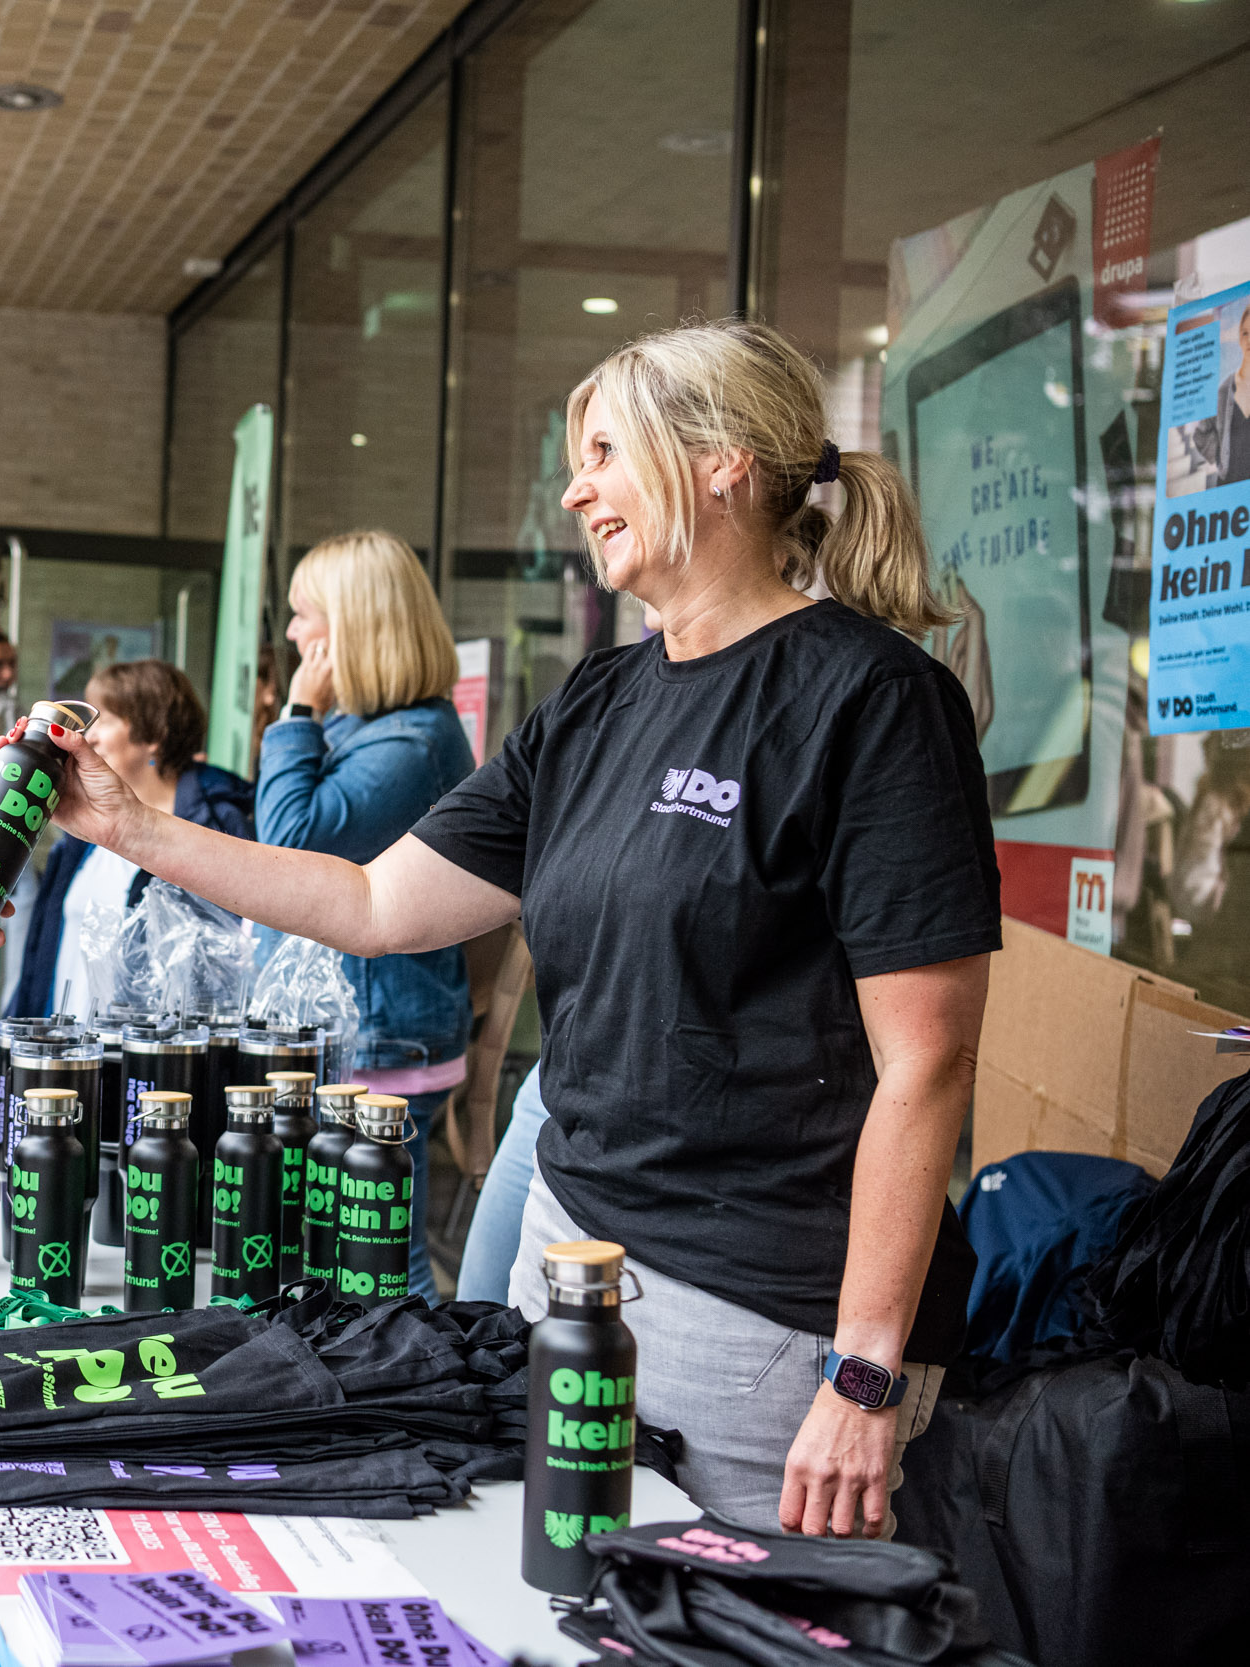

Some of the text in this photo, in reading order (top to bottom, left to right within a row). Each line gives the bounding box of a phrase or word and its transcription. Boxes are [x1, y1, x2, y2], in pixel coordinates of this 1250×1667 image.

[1101, 255, 1144, 286] drupa
[1163, 505, 1249, 551] Ohne
[1160, 556, 1232, 602] kein
[1202, 606, 1222, 620] Deine
[1173, 696, 1193, 717] DO
[1196, 702, 1238, 717] Dortmund
[680, 767, 741, 812] DO
[126, 1077, 137, 1102] Du
[128, 1164, 162, 1192] Du
[214, 1157, 244, 1185] Du
[306, 1158, 338, 1186] Du
[213, 1186, 241, 1214] O!
[305, 1185, 335, 1214] O!
[341, 1171, 395, 1201] hne
[12, 1193, 37, 1221] O!
[340, 1203, 412, 1230] ein D
[352, 1234, 371, 1244] Deine
[372, 1236, 392, 1245] Wahl.
[341, 1268, 407, 1296] DO Stadt
[550, 1367, 635, 1407] Ohn
[547, 1410, 635, 1450] kein
[546, 1456, 577, 1471] Deine
[578, 1460, 610, 1472] Stadt.
[197, 1511, 223, 1530] EIN
[165, 1573, 232, 1610] Ohne
[222, 1611, 273, 1634] Du
[401, 1603, 438, 1642] Ohne
